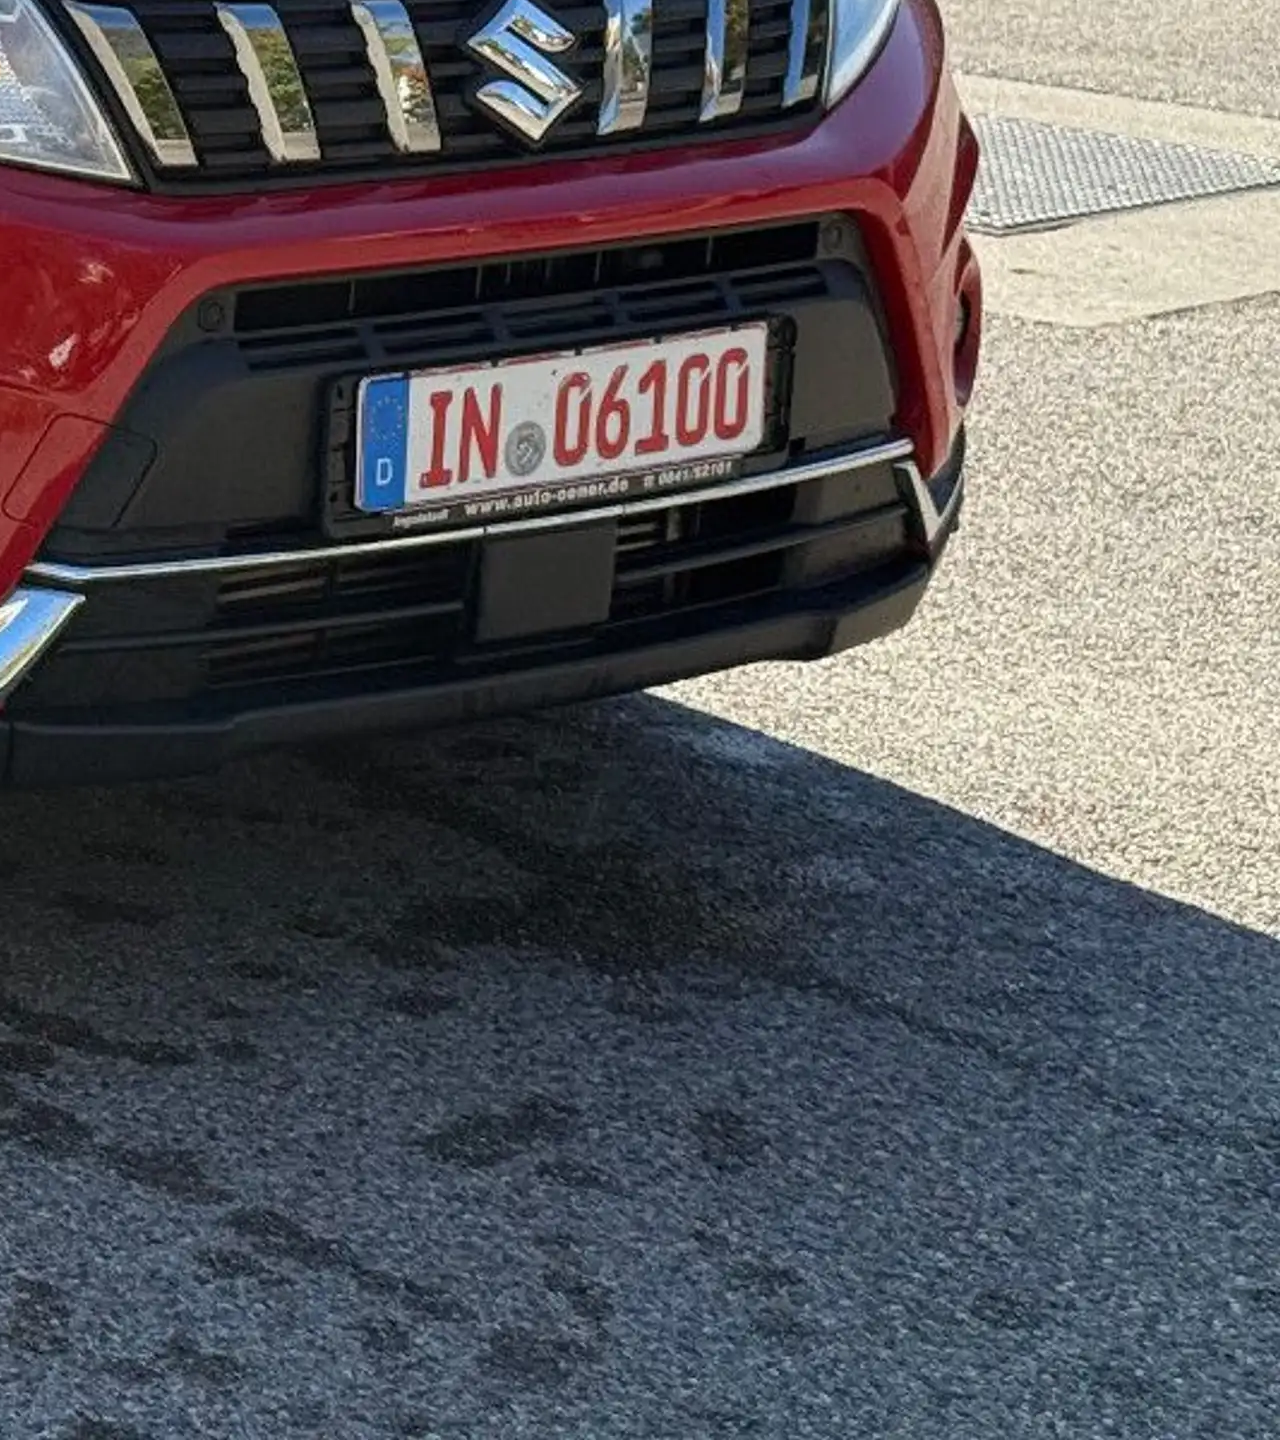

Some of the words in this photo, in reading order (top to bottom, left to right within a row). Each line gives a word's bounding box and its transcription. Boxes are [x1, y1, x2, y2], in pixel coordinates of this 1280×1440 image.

[419, 383, 503, 489] IN
[552, 347, 750, 468] 06100
[376, 457, 393, 486] D
